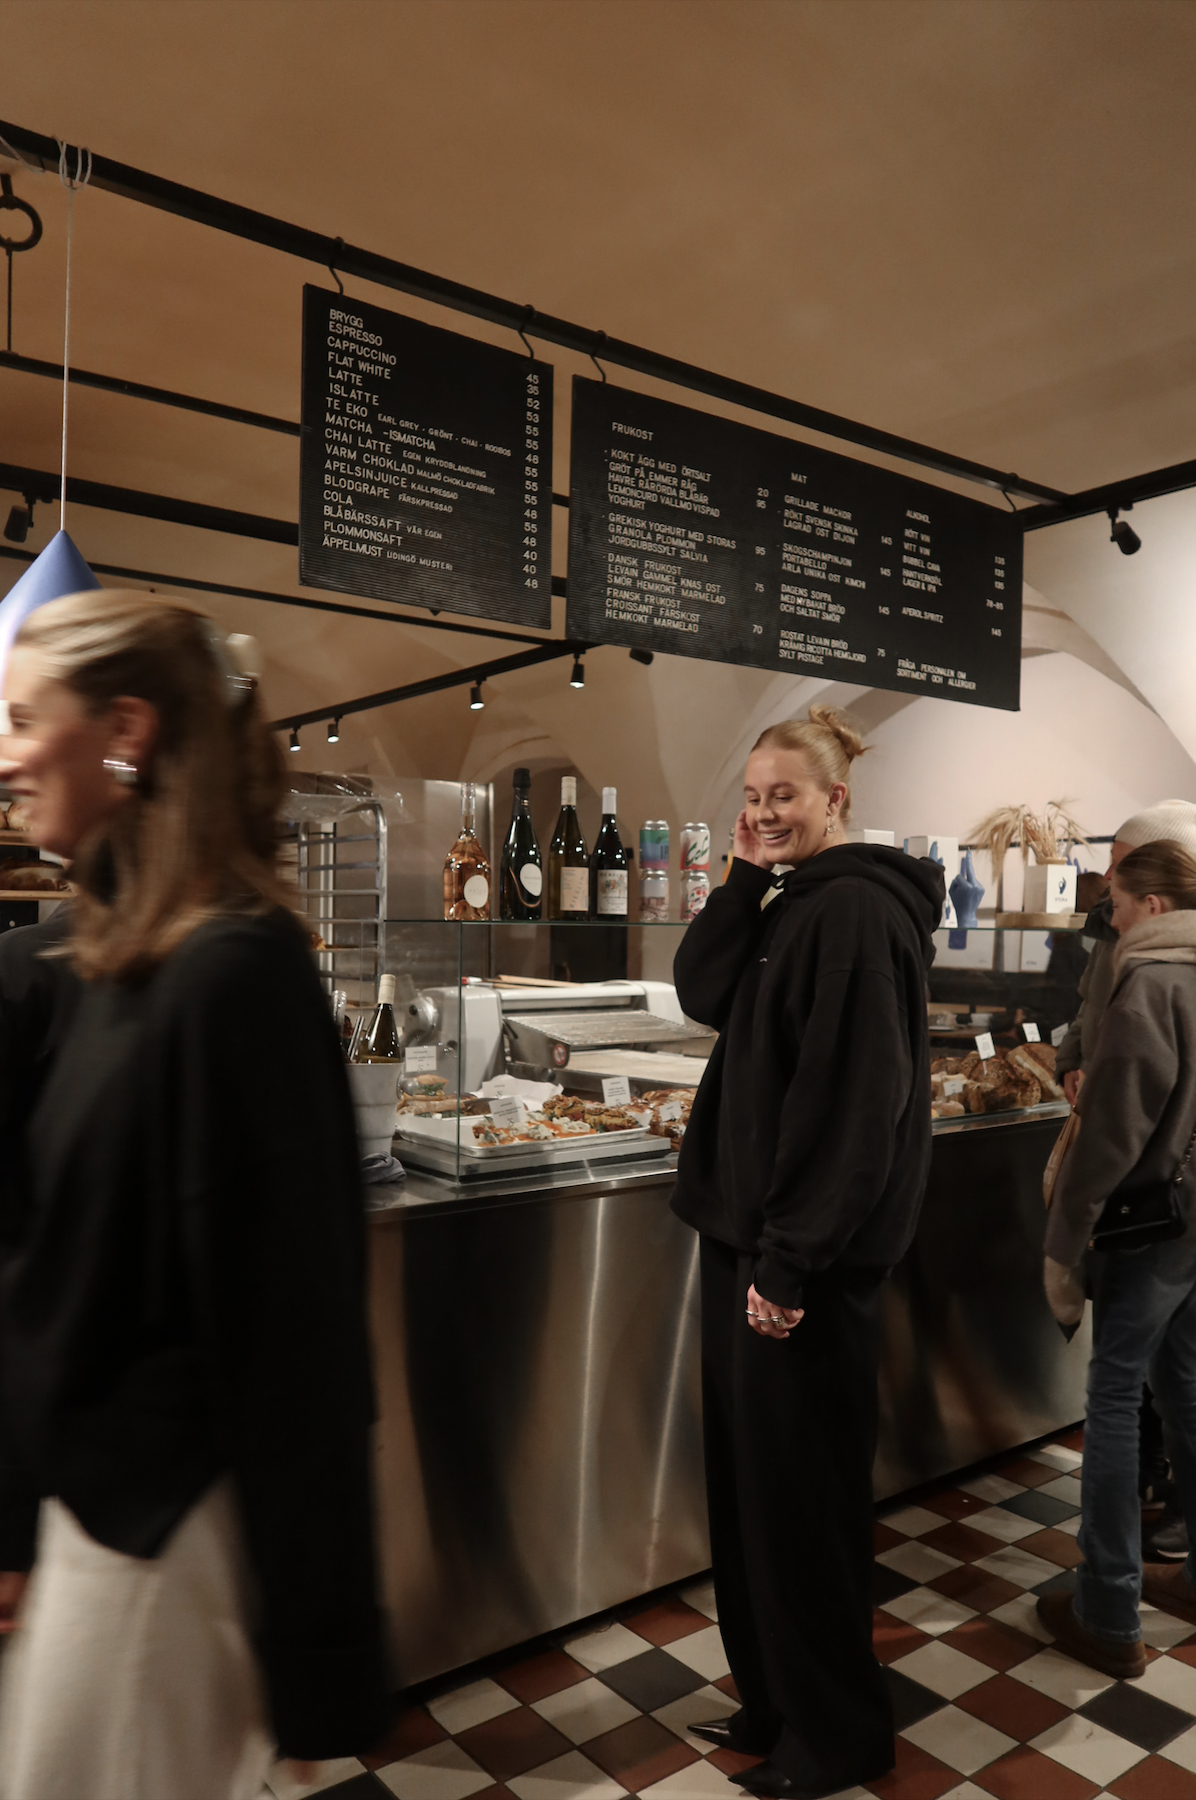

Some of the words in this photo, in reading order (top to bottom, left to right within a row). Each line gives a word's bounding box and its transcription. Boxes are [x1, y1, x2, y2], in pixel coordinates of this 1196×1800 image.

[329, 308, 364, 329] BRYGG
[526, 374, 539, 384] 45
[329, 321, 383, 346] ESPRESSO
[527, 385, 539, 395] 35
[327, 336, 397, 366] CAPPUCCINO
[527, 398, 540, 410] 52
[328, 352, 353, 368] FLAT
[358, 360, 391, 380] WHITE
[526, 411, 539, 423] 53
[329, 367, 363, 386] LATTE
[525, 425, 539, 436] 55
[329, 383, 379, 406] ISLATTE
[525, 439, 539, 451] 55
[325, 413, 372, 434] MATCHA
[525, 466, 538, 478] 55
[326, 397, 340, 410] TE
[346, 403, 368, 418] EKO
[378, 414, 397, 426] EARL
[399, 420, 420, 431] GREY
[429, 427, 453, 441] GRÖNT
[461, 438, 478, 447] CHAI
[485, 443, 511, 457] ROOIBOS
[525, 454, 539, 464] 48
[612, 422, 653, 441] FRUKOST
[325, 428, 353, 445] CHAI
[358, 438, 392, 455] LATTE
[403, 450, 421, 461] EGEN
[425, 456, 487, 478] KRYDDBLANDNING
[525, 480, 538, 491] 55
[325, 443, 357, 460] VARM
[363, 453, 414, 475] CHOKLAD
[417, 469, 442, 481] MALMÖ
[443, 476, 495, 495] CHOKLADFABRIK
[524, 494, 538, 505] 55
[611, 449, 635, 462] KOKT
[638, 454, 655, 468] ÄGG
[658, 461, 676, 473] MED
[682, 465, 711, 482] ÖRTSALT
[757, 488, 769, 498] 20
[324, 459, 407, 488] APELSINJUICE
[411, 482, 458, 499] KALLPRESSAD
[524, 509, 538, 519] 48
[608, 472, 636, 486] HAVRE
[679, 489, 709, 504] BLÅBÄR
[608, 483, 658, 502] LEMONCURD
[609, 462, 631, 475] GRÖT
[635, 467, 645, 478] PÅ
[649, 472, 678, 487] EMMER
[681, 479, 697, 491] RÅG
[791, 472, 807, 484] MAT
[324, 474, 390, 499] BLODGRAPE
[398, 493, 453, 512] FÄRSKPRESSAD
[524, 522, 537, 533] 55
[608, 494, 646, 510] YOGHURT
[784, 495, 819, 512] GRILLADE
[323, 490, 353, 506] COLA
[522, 536, 536, 547] 48
[324, 505, 401, 531] BLÅBÄRSSAFT
[407, 525, 422, 535] VÅR
[425, 530, 442, 539] EGEN
[523, 550, 537, 561] 40
[609, 513, 647, 529] GREKISK
[649, 522, 686, 537] YOGHURT
[688, 530, 704, 541] MED
[755, 546, 766, 556] 95
[783, 519, 811, 534] LAGRAD
[815, 527, 829, 538] OST
[833, 532, 855, 544] DIJON
[324, 521, 402, 546] PLOMMONSAFT
[523, 564, 536, 574] 40
[608, 535, 676, 556] JORDGUBBSSYLT
[680, 549, 708, 562] SALVIA
[609, 524, 652, 541] GRANOLA
[656, 534, 696, 549] PLOMMON
[322, 534, 383, 557] ÄPPELMUST
[419, 558, 452, 571] MUSTERI
[524, 578, 538, 588] 48
[608, 553, 638, 567] DANSK
[644, 560, 682, 576] FRUKOST
[755, 583, 764, 592] 75
[782, 553, 827, 570] PORTABELLO
[782, 562, 801, 574] ARLA
[804, 568, 826, 579] UNIKA
[828, 573, 841, 583] OST
[607, 574, 632, 586] SMÖR
[637, 580, 676, 595] HEMKOKT
[681, 588, 726, 605] MARMELAD
[608, 564, 638, 577] LEVAIN
[643, 571, 677, 584] GAMMEL
[680, 578, 702, 590] KNAS
[706, 583, 721, 593] OST
[607, 588, 641, 602] FRANSK
[645, 594, 681, 609] FRUKOST
[780, 594, 795, 604] MED
[780, 603, 794, 613] OCH
[781, 584, 808, 597] DAGENS
[878, 606, 890, 615] 145
[606, 598, 653, 615] CROISSANT
[753, 624, 763, 634] 70
[606, 609, 649, 624] HEMKOKT
[654, 618, 699, 633] MARMELAD
[779, 650, 796, 659] SYLT
[877, 648, 886, 657] 75
